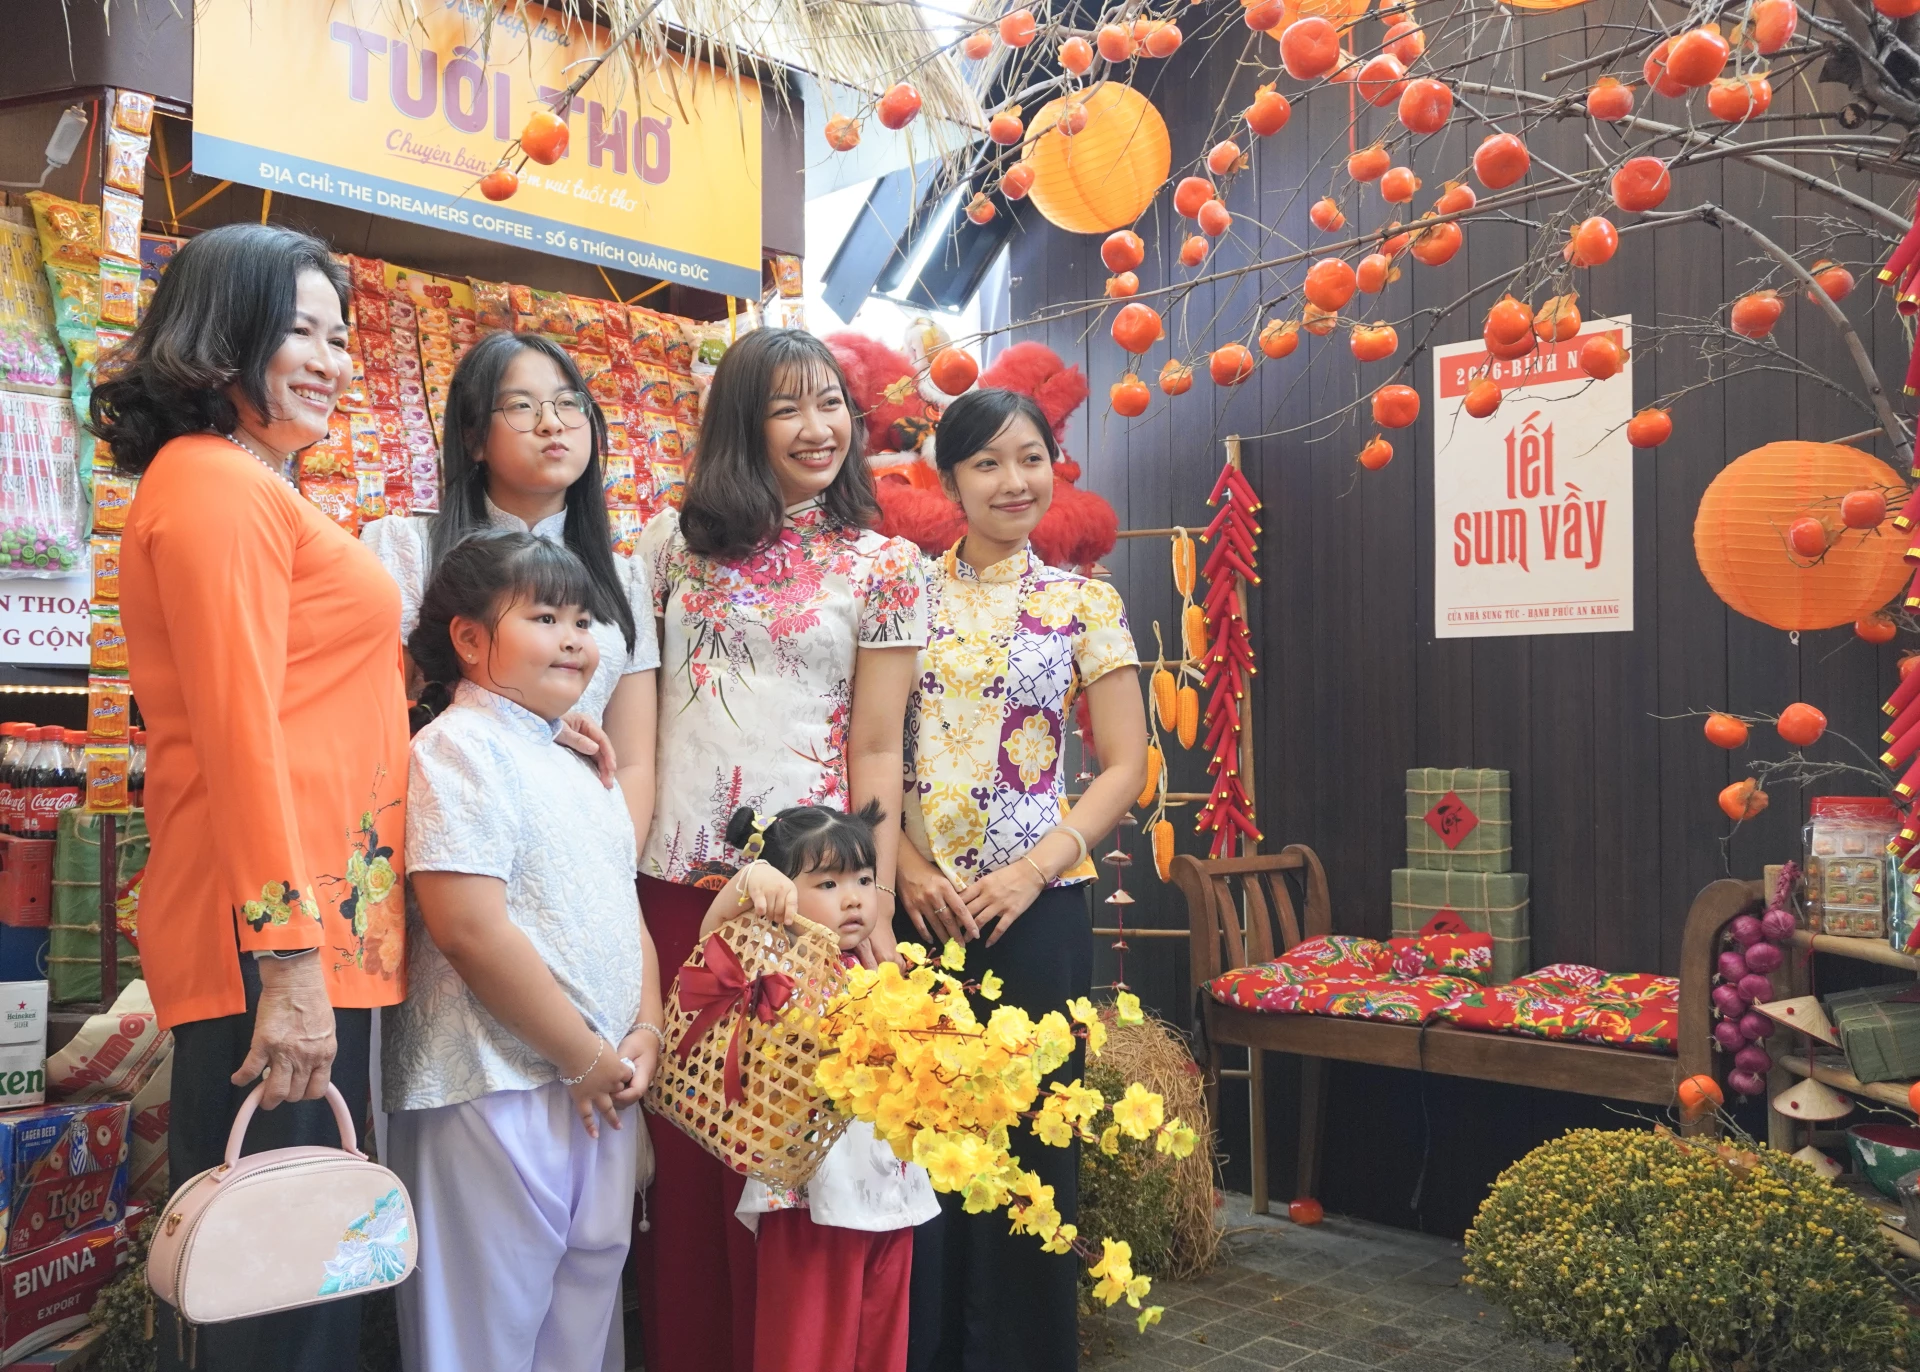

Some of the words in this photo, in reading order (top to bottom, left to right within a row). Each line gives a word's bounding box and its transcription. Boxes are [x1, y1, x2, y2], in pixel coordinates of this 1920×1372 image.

[385, 128, 452, 164] Chuyên
[259, 162, 294, 184] ĐỊA
[297, 173, 334, 193] CHỈ:
[337, 180, 373, 203] THE
[377, 190, 469, 225] DREAMERS
[472, 213, 533, 240] COFFEE
[545, 230, 566, 248] SỐ
[569, 237, 579, 251] 6
[580, 239, 625, 262] THÍCH
[627, 251, 677, 274] QUẢNG
[680, 263, 709, 282] ĐỨC
[63, 438, 72, 453] 83
[1454, 508, 1530, 573] sum
[1540, 482, 1607, 570] vầy
[18, 596, 91, 619] THOẠ
[1482, 610, 1502, 619] SUNG
[1552, 606, 1574, 616] PHÚC
[1576, 606, 1587, 615] AN
[1590, 605, 1619, 615] KHANG
[7, 1012, 36, 1020] Heineken
[21, 1128, 40, 1142] LAGER
[41, 1126, 56, 1138] BEER
[47, 1180, 104, 1228] Tiger
[19, 1228, 29, 1241] 24
[13, 1246, 96, 1299] BIVINA
[37, 1293, 82, 1320] EXPORT
